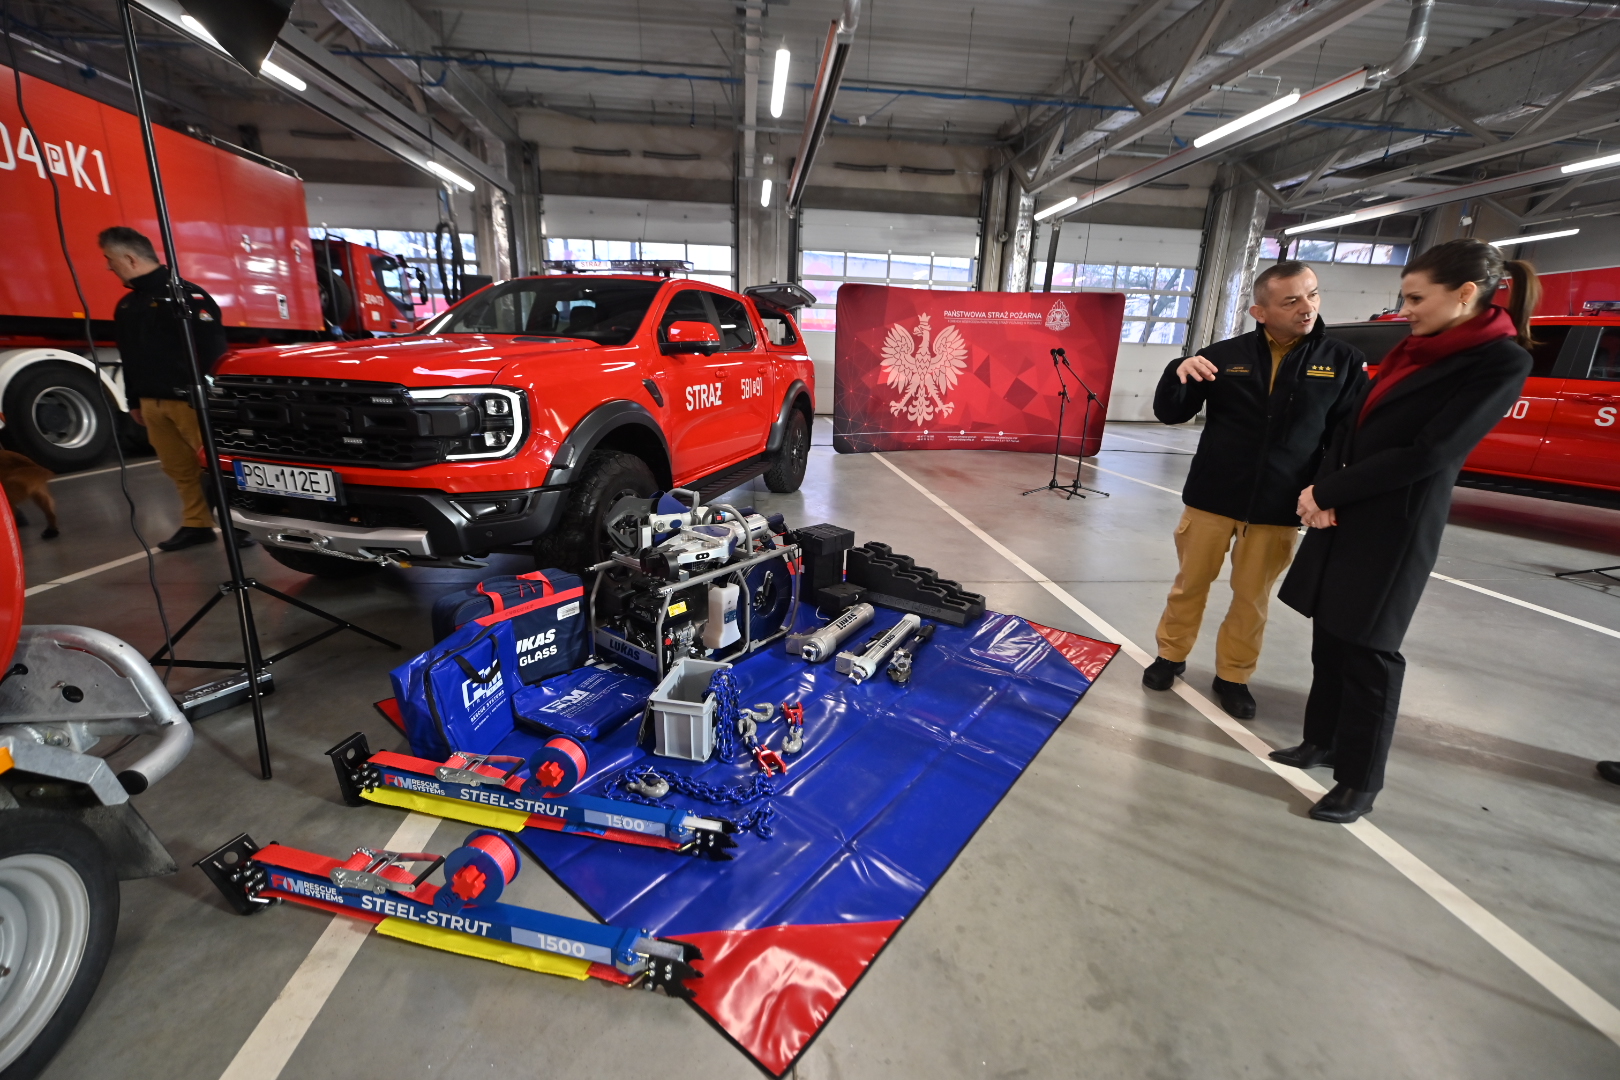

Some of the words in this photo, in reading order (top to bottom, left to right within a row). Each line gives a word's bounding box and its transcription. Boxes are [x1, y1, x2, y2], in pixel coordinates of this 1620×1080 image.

[943, 309, 987, 318] PAŃSTWOWA
[987, 311, 1009, 319] STRAŻ
[1009, 311, 1042, 319] POŻARNA
[685, 382, 723, 411] STRAŻ
[243, 464, 276, 488] PSL
[280, 468, 332, 494] 112EJ
[519, 644, 557, 667] GLASS
[609, 639, 640, 661] LUKAS
[411, 779, 440, 789] RESCUE
[412, 785, 446, 796] SYSTEMS
[460, 788, 569, 818] STEEL-STRUT
[605, 814, 645, 832] 1500
[303, 881, 337, 895] RESCUE
[304, 888, 344, 904] SYSTEMS
[361, 895, 492, 936] STEEL-STRUT
[537, 933, 586, 957] 1500
